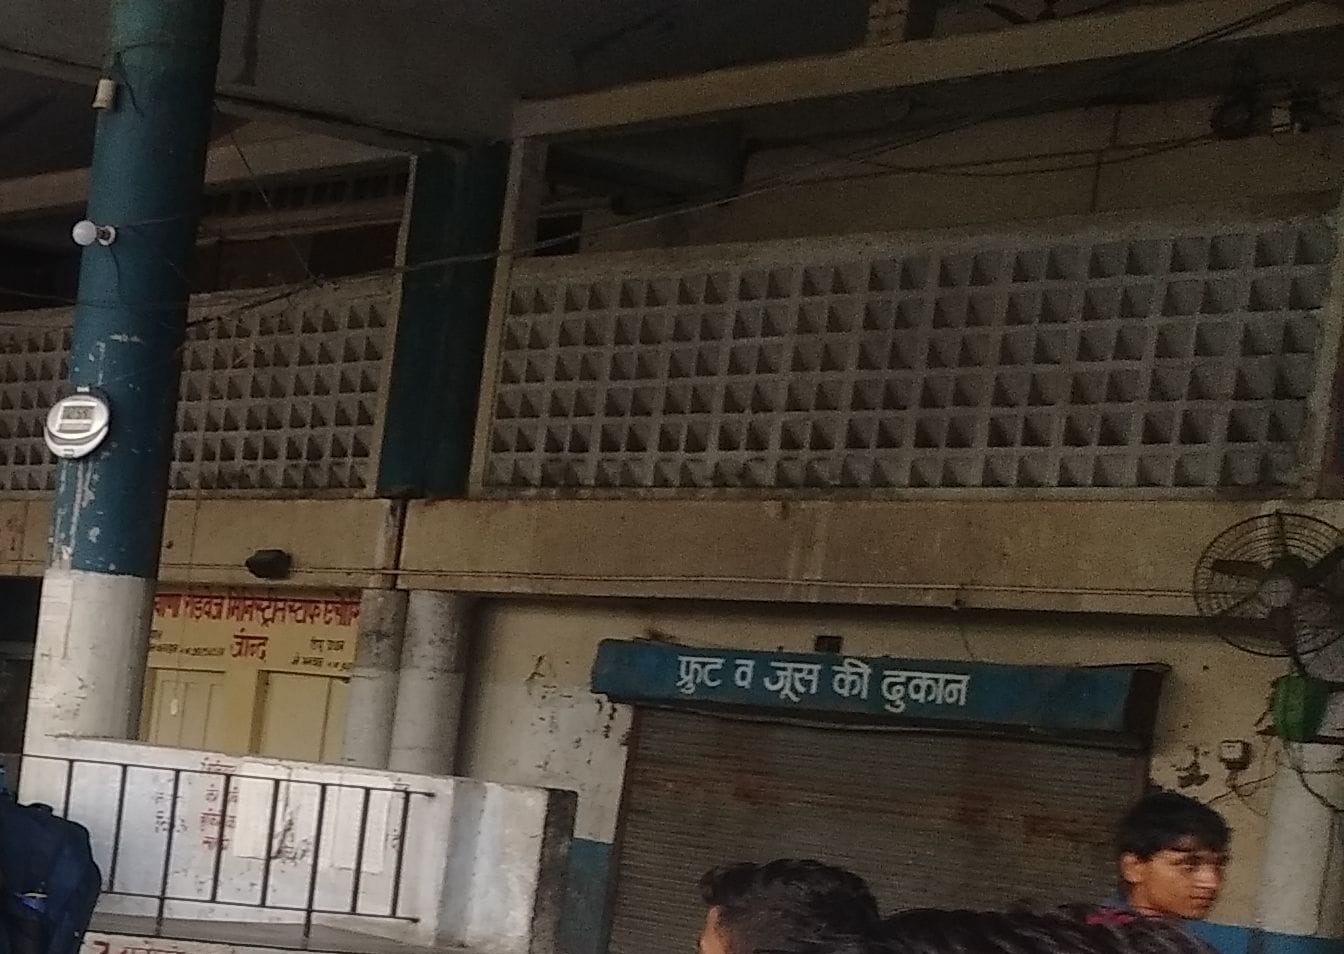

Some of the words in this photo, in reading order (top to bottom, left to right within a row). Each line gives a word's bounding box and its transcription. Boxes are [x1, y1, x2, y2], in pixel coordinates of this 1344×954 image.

[676, 656, 725, 695] फ्रुट
[734, 659, 755, 689] व
[764, 662, 821, 702] जूस
[832, 657, 871, 699] की
[881, 670, 970, 713] दुकान
